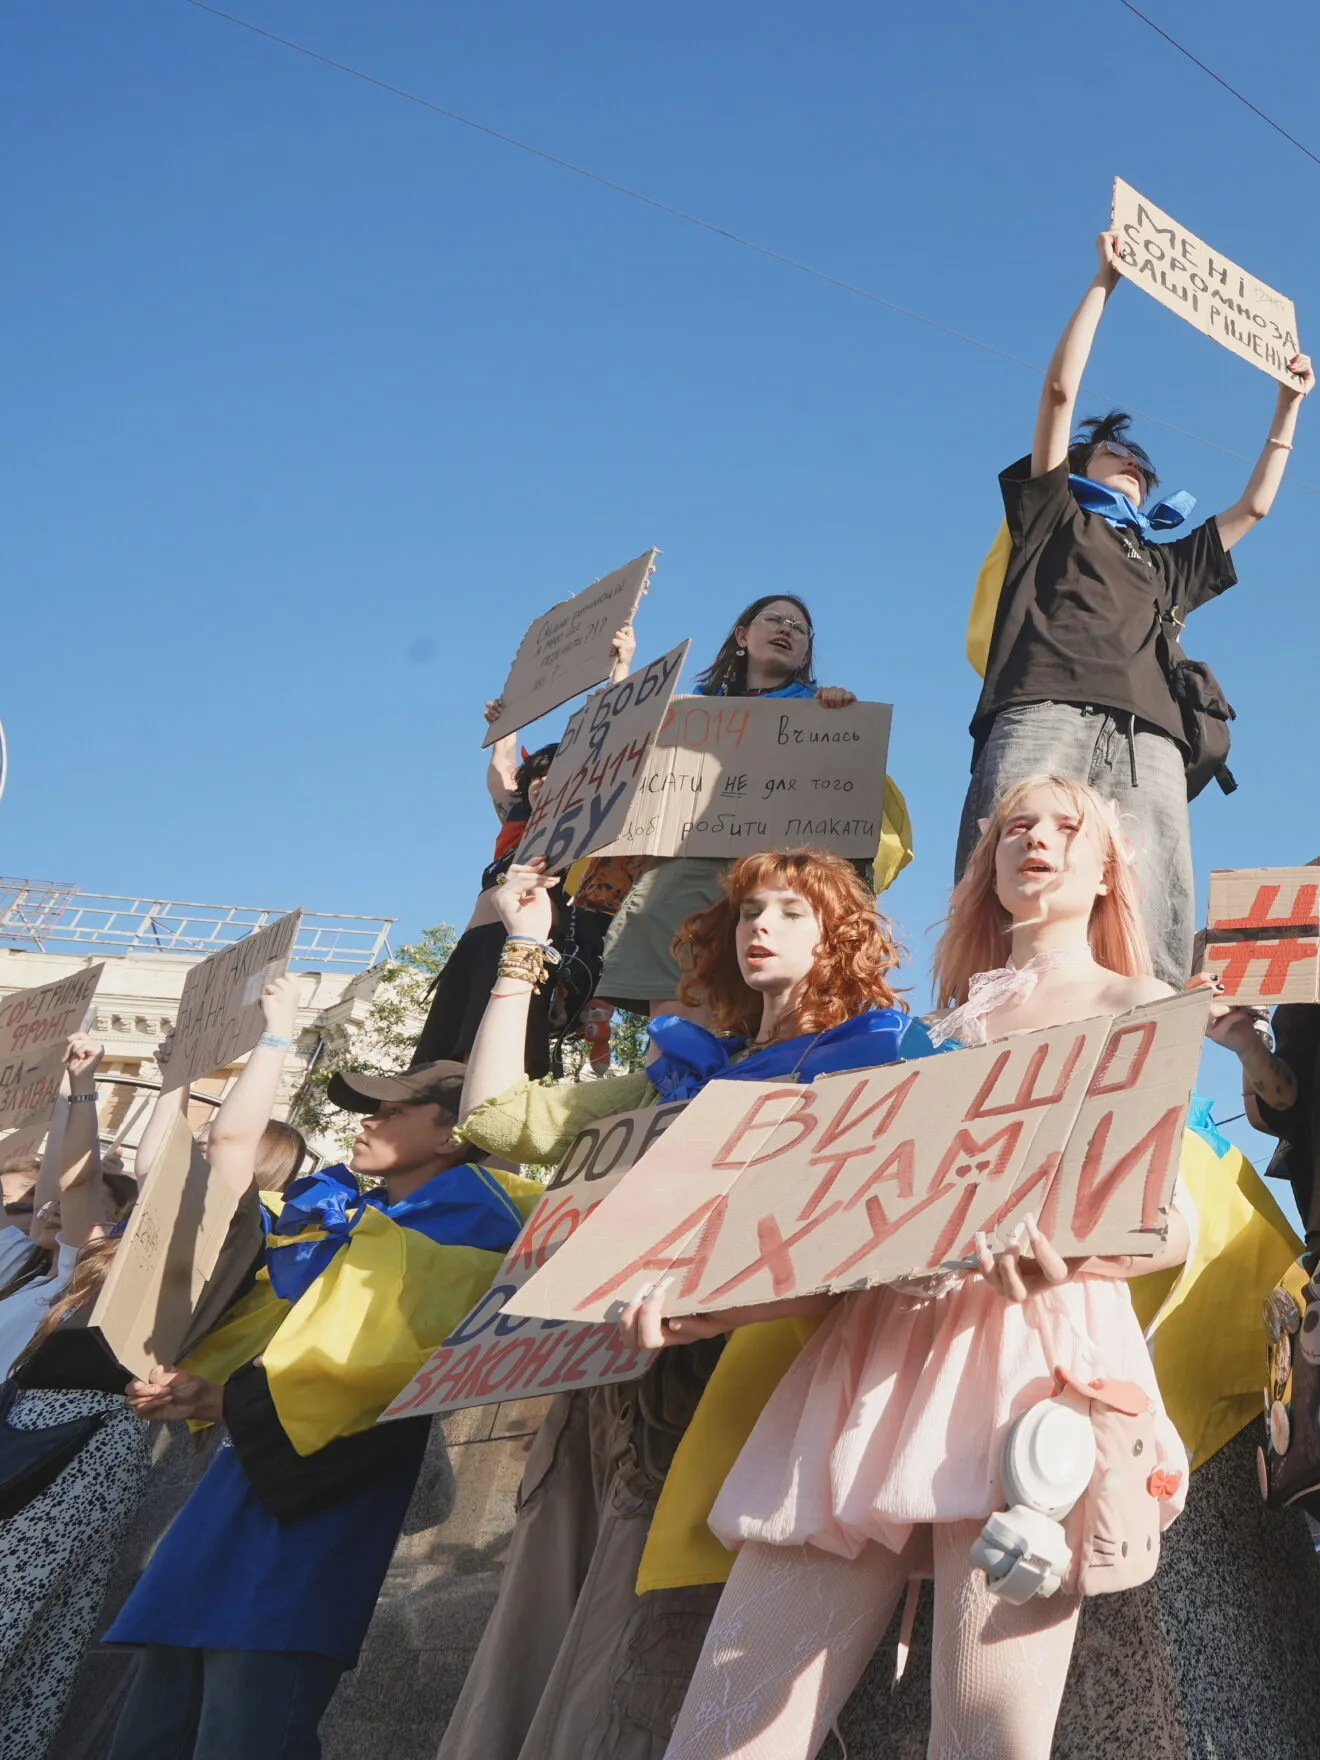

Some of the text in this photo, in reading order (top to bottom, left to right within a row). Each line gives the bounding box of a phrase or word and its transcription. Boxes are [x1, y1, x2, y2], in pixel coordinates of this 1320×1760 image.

[1122, 241, 1198, 313] ВАШІ
[1137, 203, 1245, 298] МЕНІ
[655, 708, 750, 748] 2014
[720, 773, 748, 798] НЕ
[711, 1070, 920, 1170] ВИ
[962, 1021, 1158, 1123] ШО
[798, 1120, 1026, 1222] ТАМ
